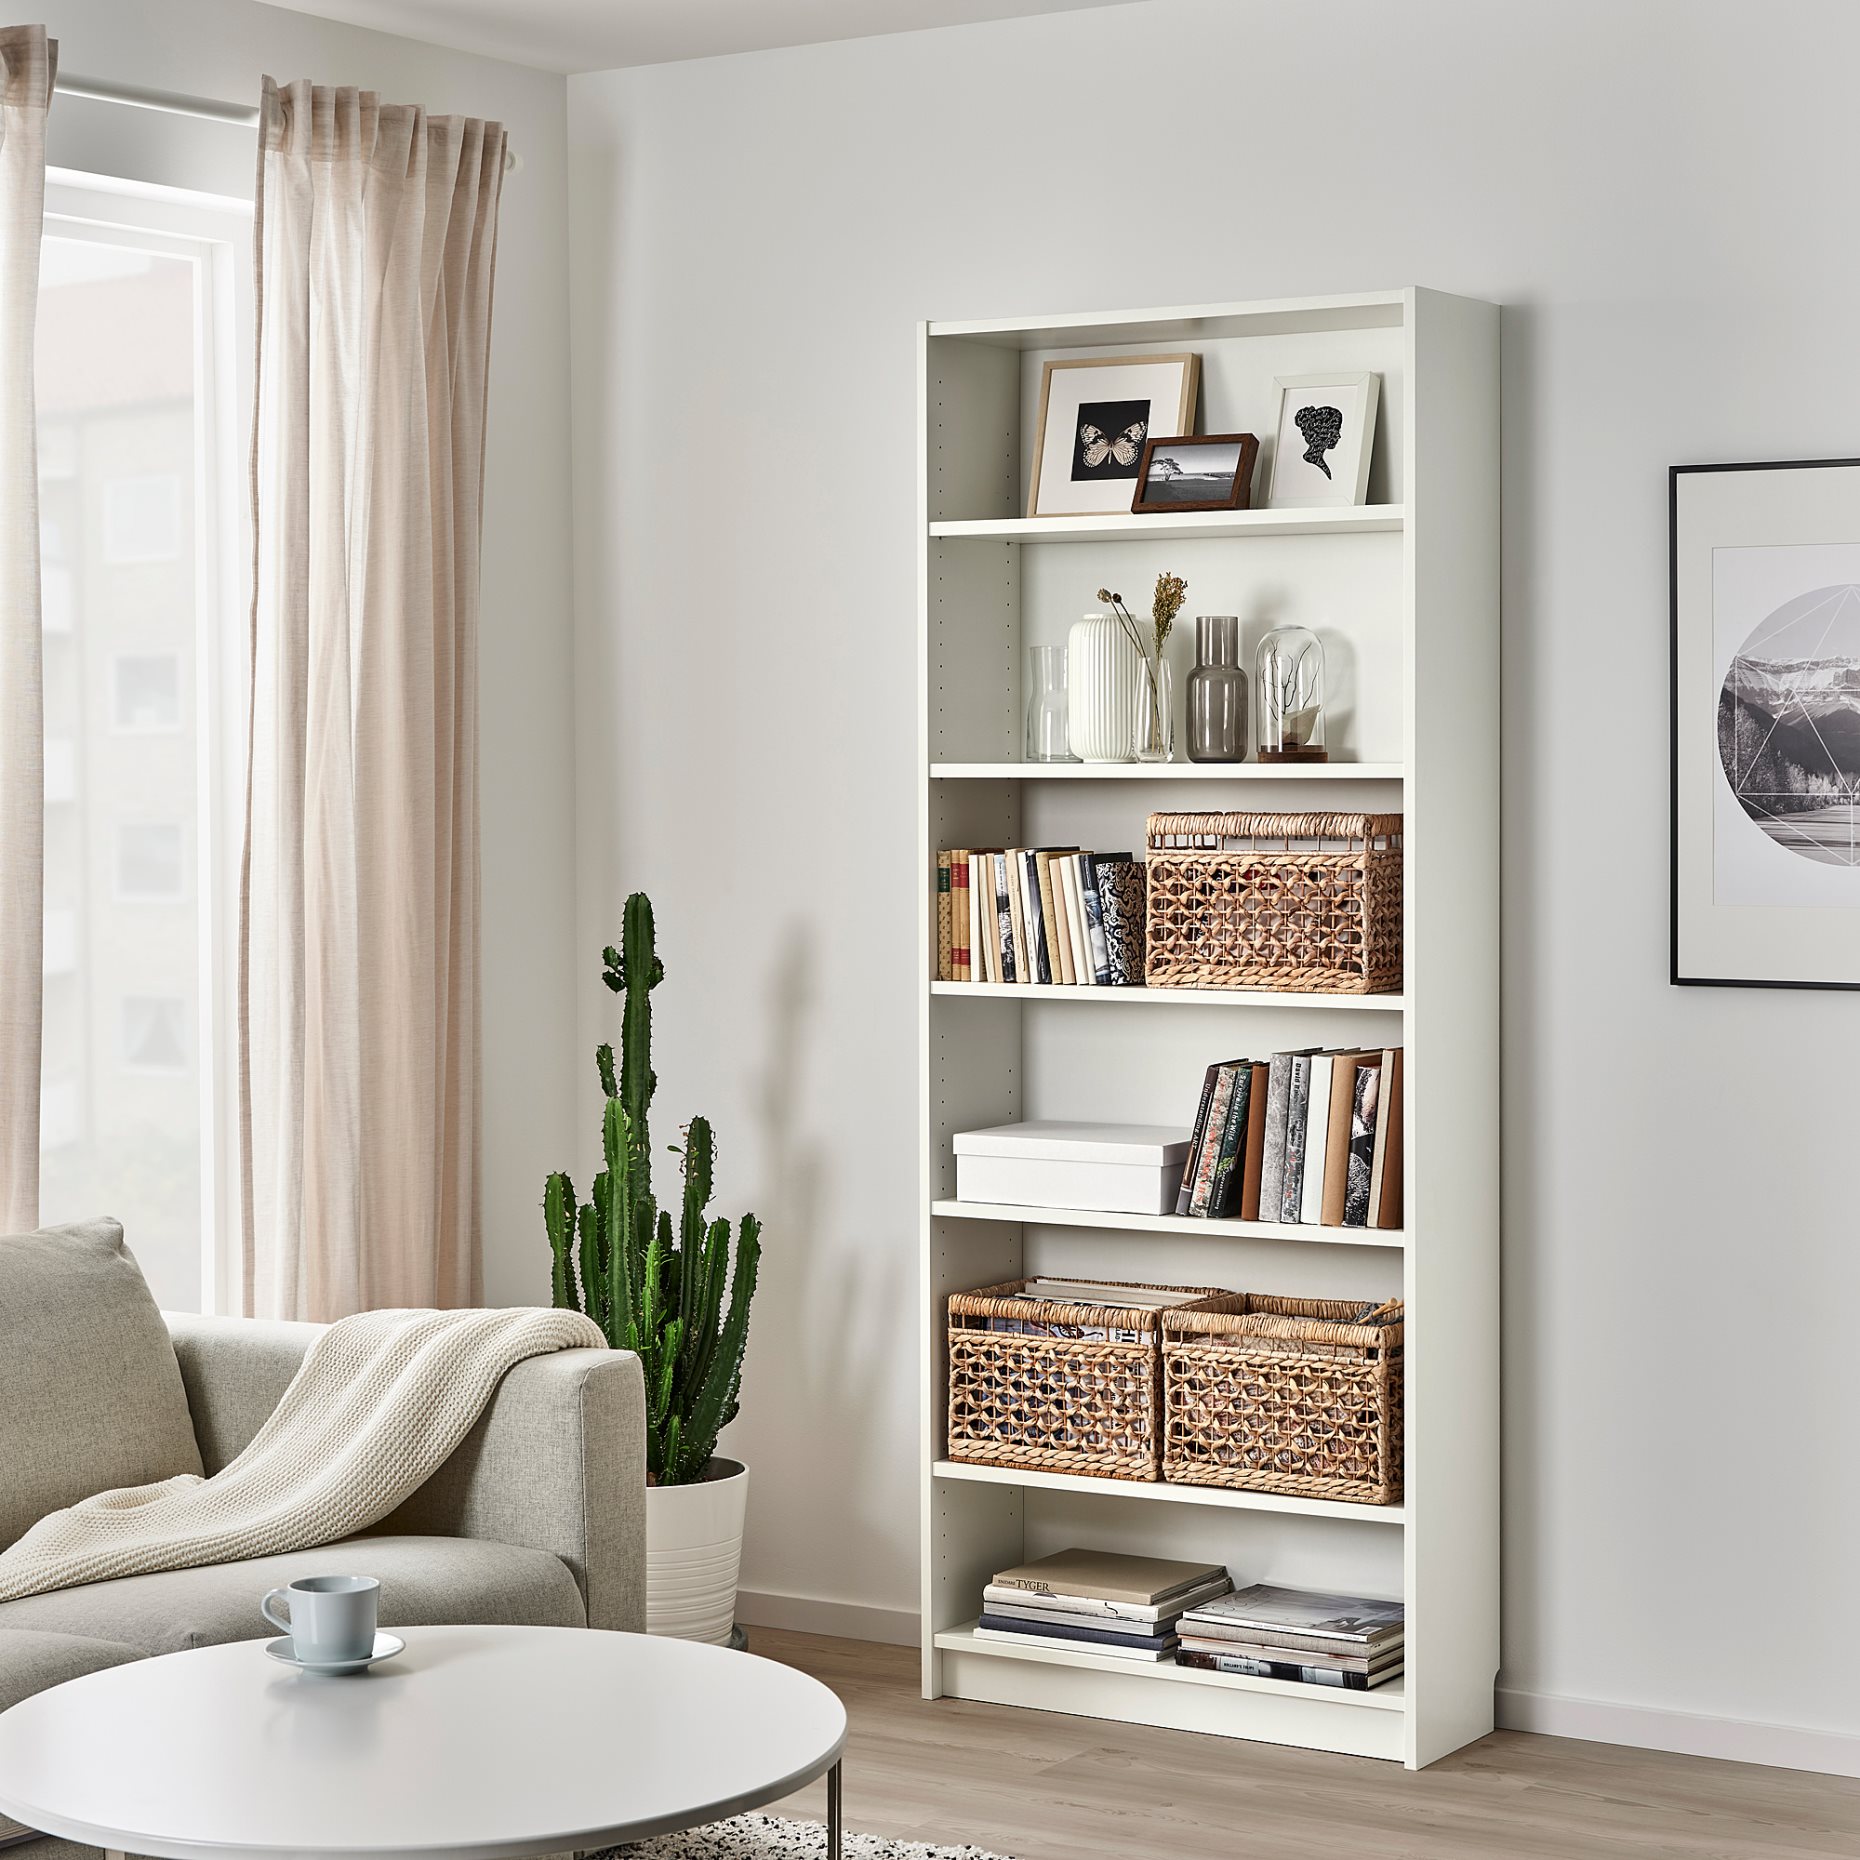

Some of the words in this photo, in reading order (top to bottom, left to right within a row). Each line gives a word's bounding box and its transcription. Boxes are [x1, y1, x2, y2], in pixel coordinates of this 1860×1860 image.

[1294, 1062, 1302, 1083] David
[1235, 1074, 1247, 1102] Survive
[1194, 1082, 1211, 1134] Understanding
[1231, 1111, 1239, 1124] the
[1228, 1124, 1237, 1141] Wild
[1016, 1579, 1050, 1592] TYGER
